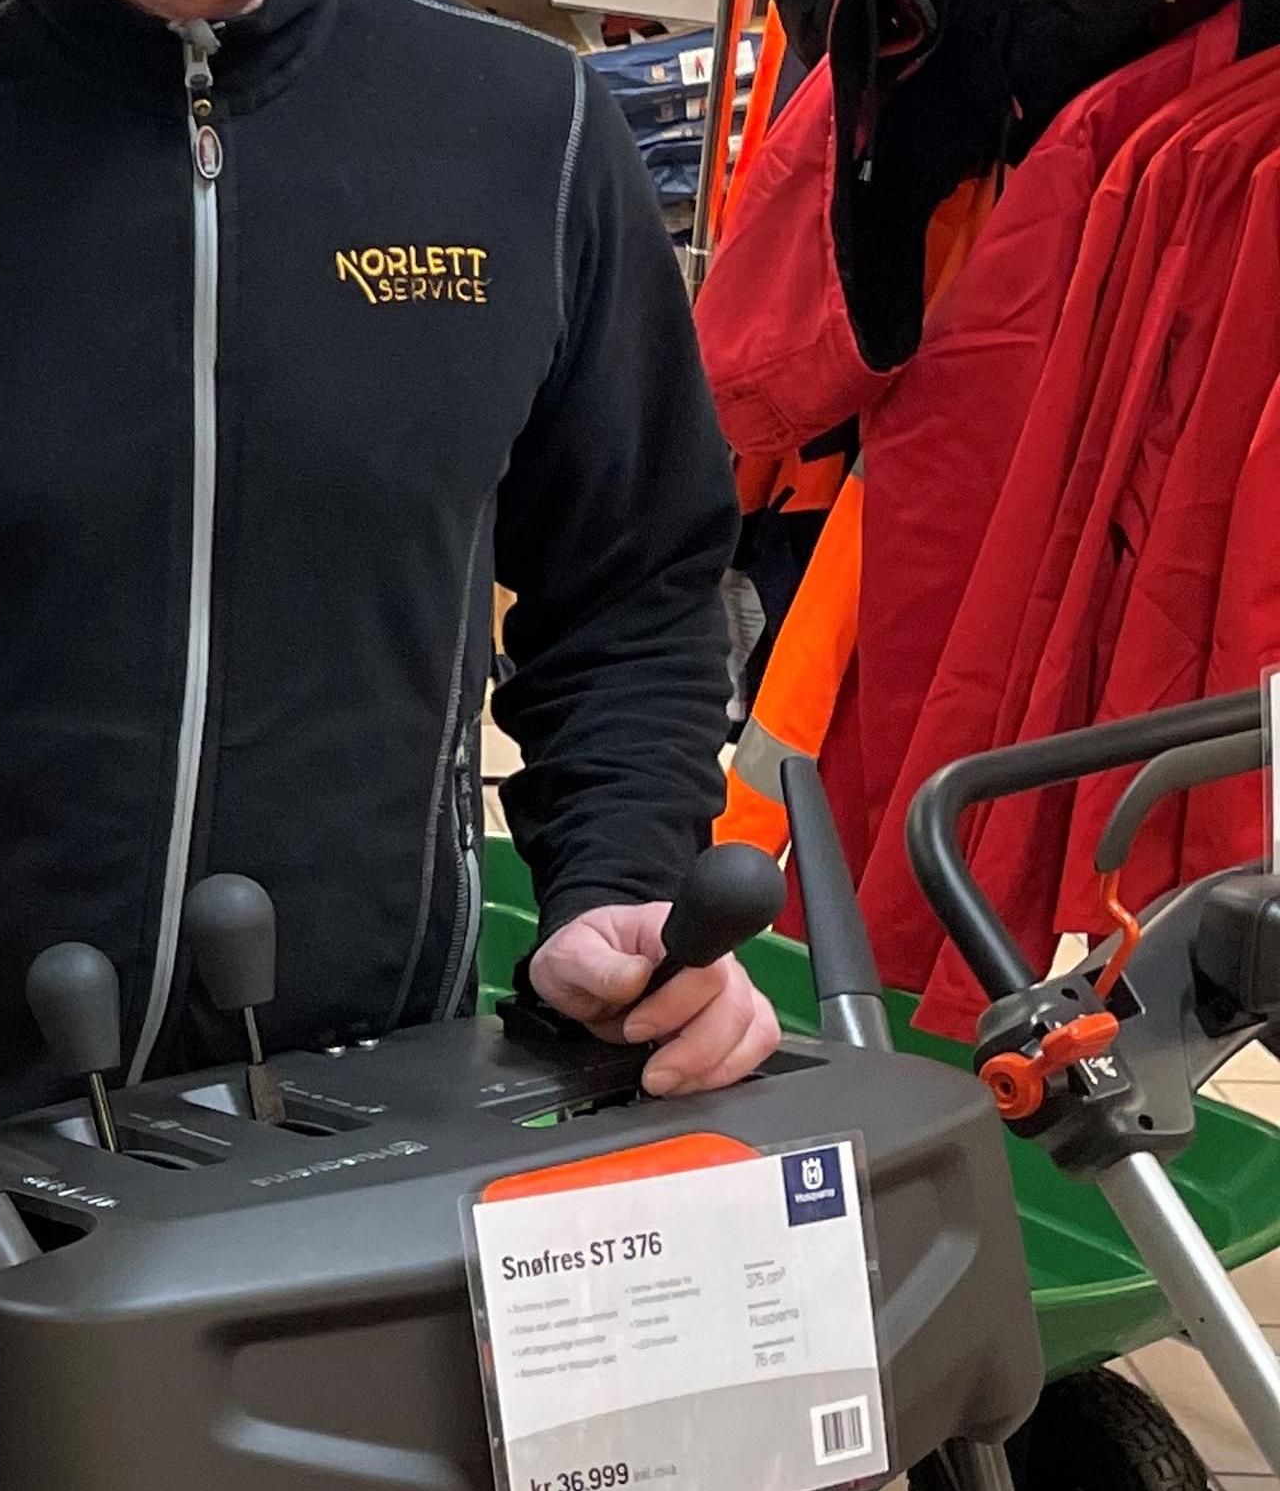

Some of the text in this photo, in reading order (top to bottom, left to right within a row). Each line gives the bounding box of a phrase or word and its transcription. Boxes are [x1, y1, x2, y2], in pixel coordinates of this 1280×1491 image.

[336, 245, 488, 304] NORLETT
[378, 277, 490, 303] SERVICE
[502, 1231, 662, 1282] Snøfres ST 376
